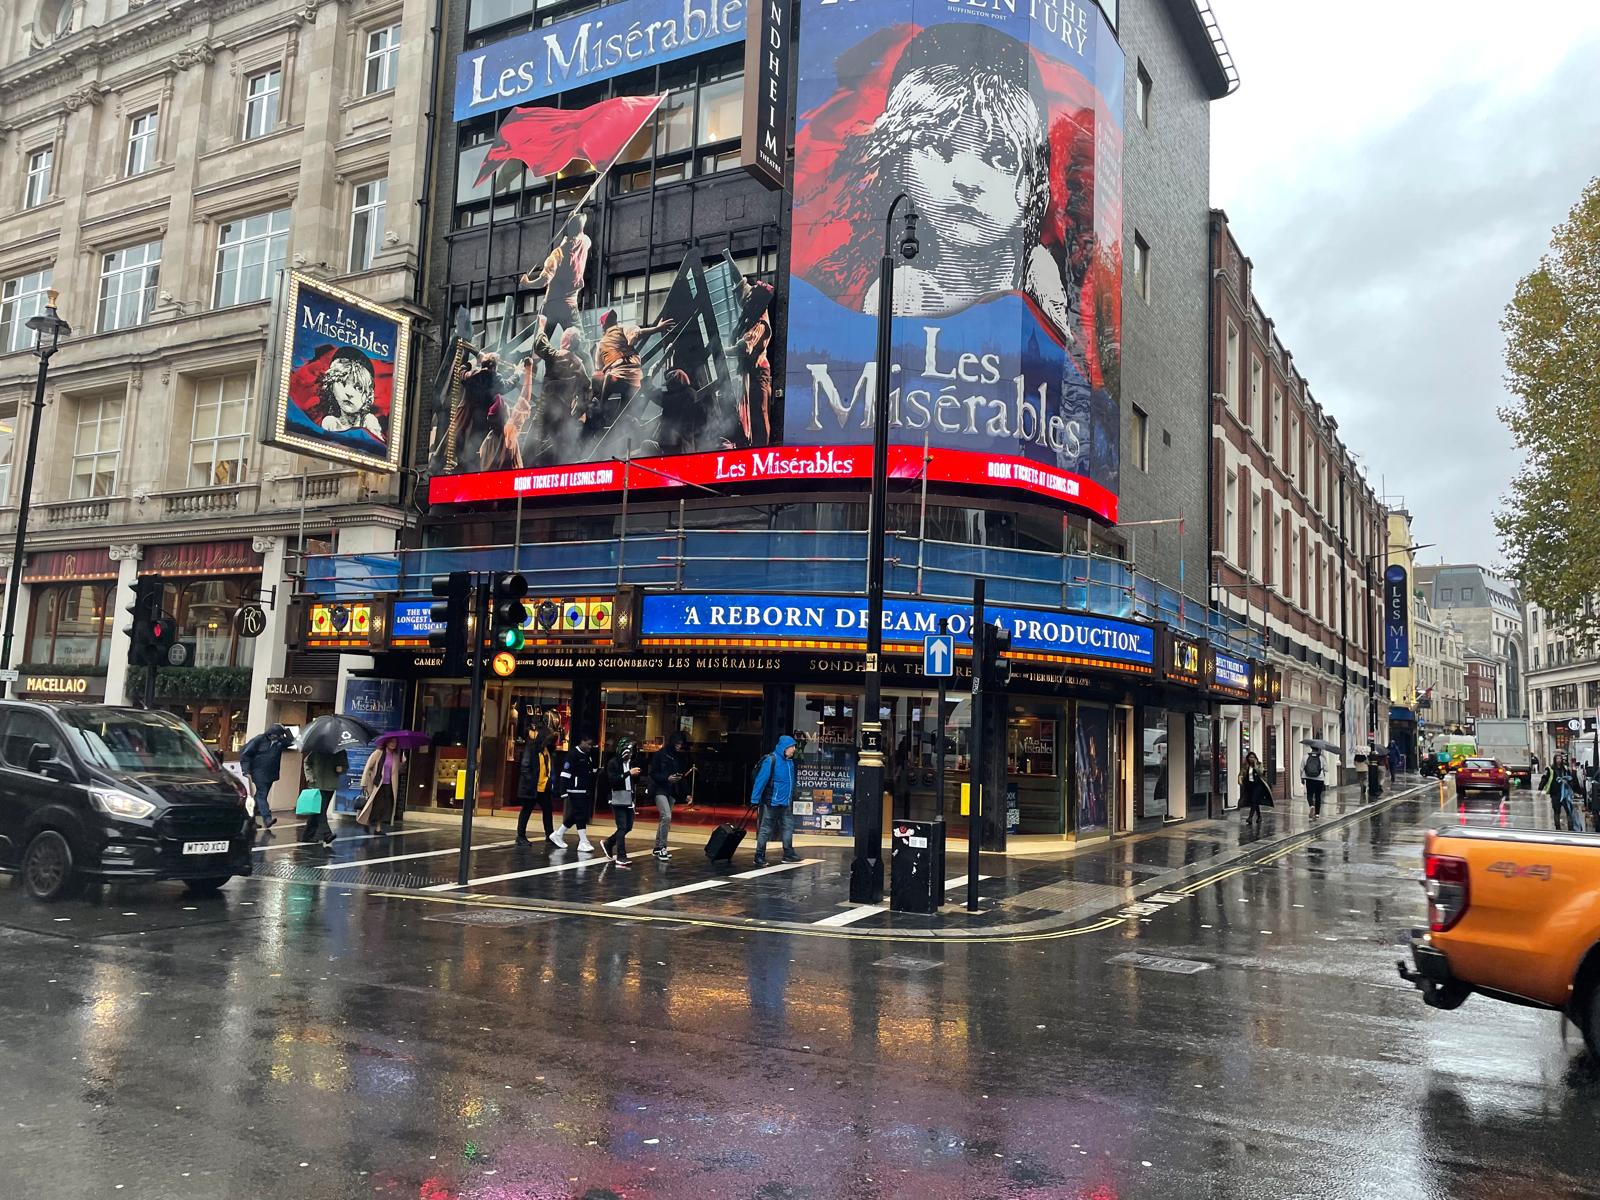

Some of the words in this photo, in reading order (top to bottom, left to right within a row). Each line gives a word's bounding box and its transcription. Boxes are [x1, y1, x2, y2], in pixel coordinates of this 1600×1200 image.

[947, 5, 989, 18] HUFFINGTON
[991, 13, 1008, 21] POST
[469, 54, 534, 107] Les
[543, 0, 748, 86] Misérable
[759, 150, 782, 174] THEATRE
[335, 308, 358, 330] Les
[302, 305, 389, 356] Misérables
[921, 326, 1000, 385] Les
[805, 362, 1081, 458] Misérables
[715, 456, 746, 480] Les
[752, 449, 854, 477] Misérables
[514, 476, 532, 491] BOOK
[533, 474, 560, 489] TICKETS
[560, 473, 568, 487] AT
[569, 469, 613, 487] LESMIS.COM
[988, 461, 1011, 479] BOOK
[1013, 464, 1038, 485] TICKETS
[1039, 470, 1046, 487] AT
[1046, 473, 1080, 497] LESMIS.COM
[407, 608, 421, 616] THE
[710, 606, 826, 627] REBORN
[948, 614, 974, 635] O
[1390, 625, 1404, 662] MIZ
[414, 658, 443, 666] CAMER
[536, 659, 573, 667] BOUBLIL
[576, 659, 596, 667] AND
[668, 657, 690, 668] LES
[696, 655, 781, 669] MISÉRABLES
[809, 659, 897, 674] SONDHM
[904, 663, 973, 677] THRE
[26, 677, 87, 693] MACELLAIO
[796, 780, 828, 788] SHOWS
[830, 781, 852, 789] HERE
[821, 770, 836, 778] FOR
